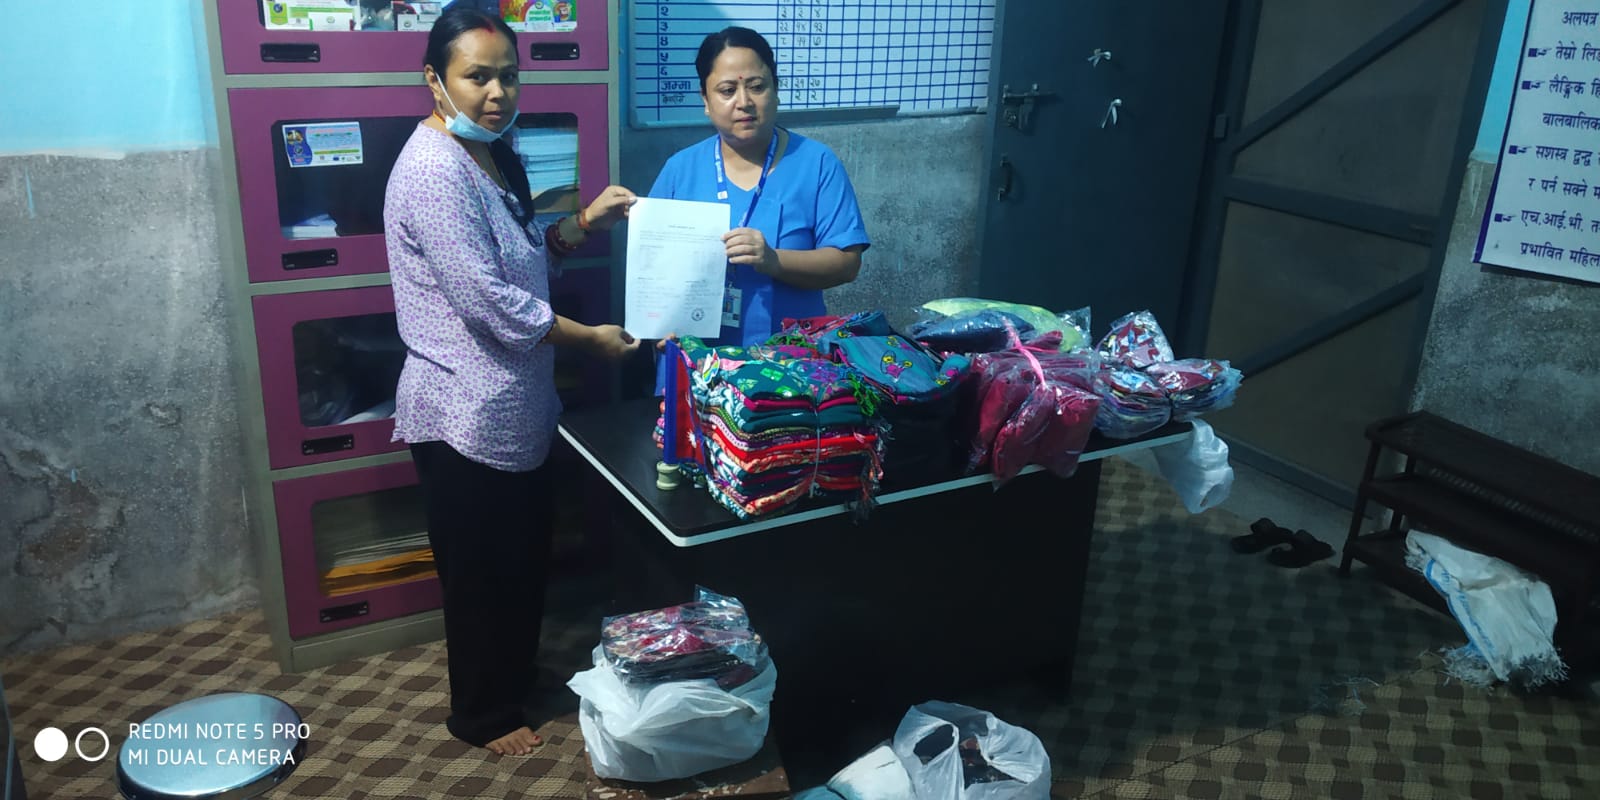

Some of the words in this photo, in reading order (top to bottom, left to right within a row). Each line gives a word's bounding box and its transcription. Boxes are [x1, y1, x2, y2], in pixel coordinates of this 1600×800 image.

[1562, 11, 1599, 26] अलपत्र
[1555, 40, 1578, 60] तेस्रो
[661, 80, 691, 91] जम्मा
[1535, 145, 1569, 161] सशस्त्र
[1573, 149, 1593, 167] द्वन्द्व
[1528, 178, 1536, 190] र
[1541, 176, 1558, 193] पर्न
[1563, 178, 1588, 198] सक्ने
[1520, 241, 1564, 261] प्रभावित
